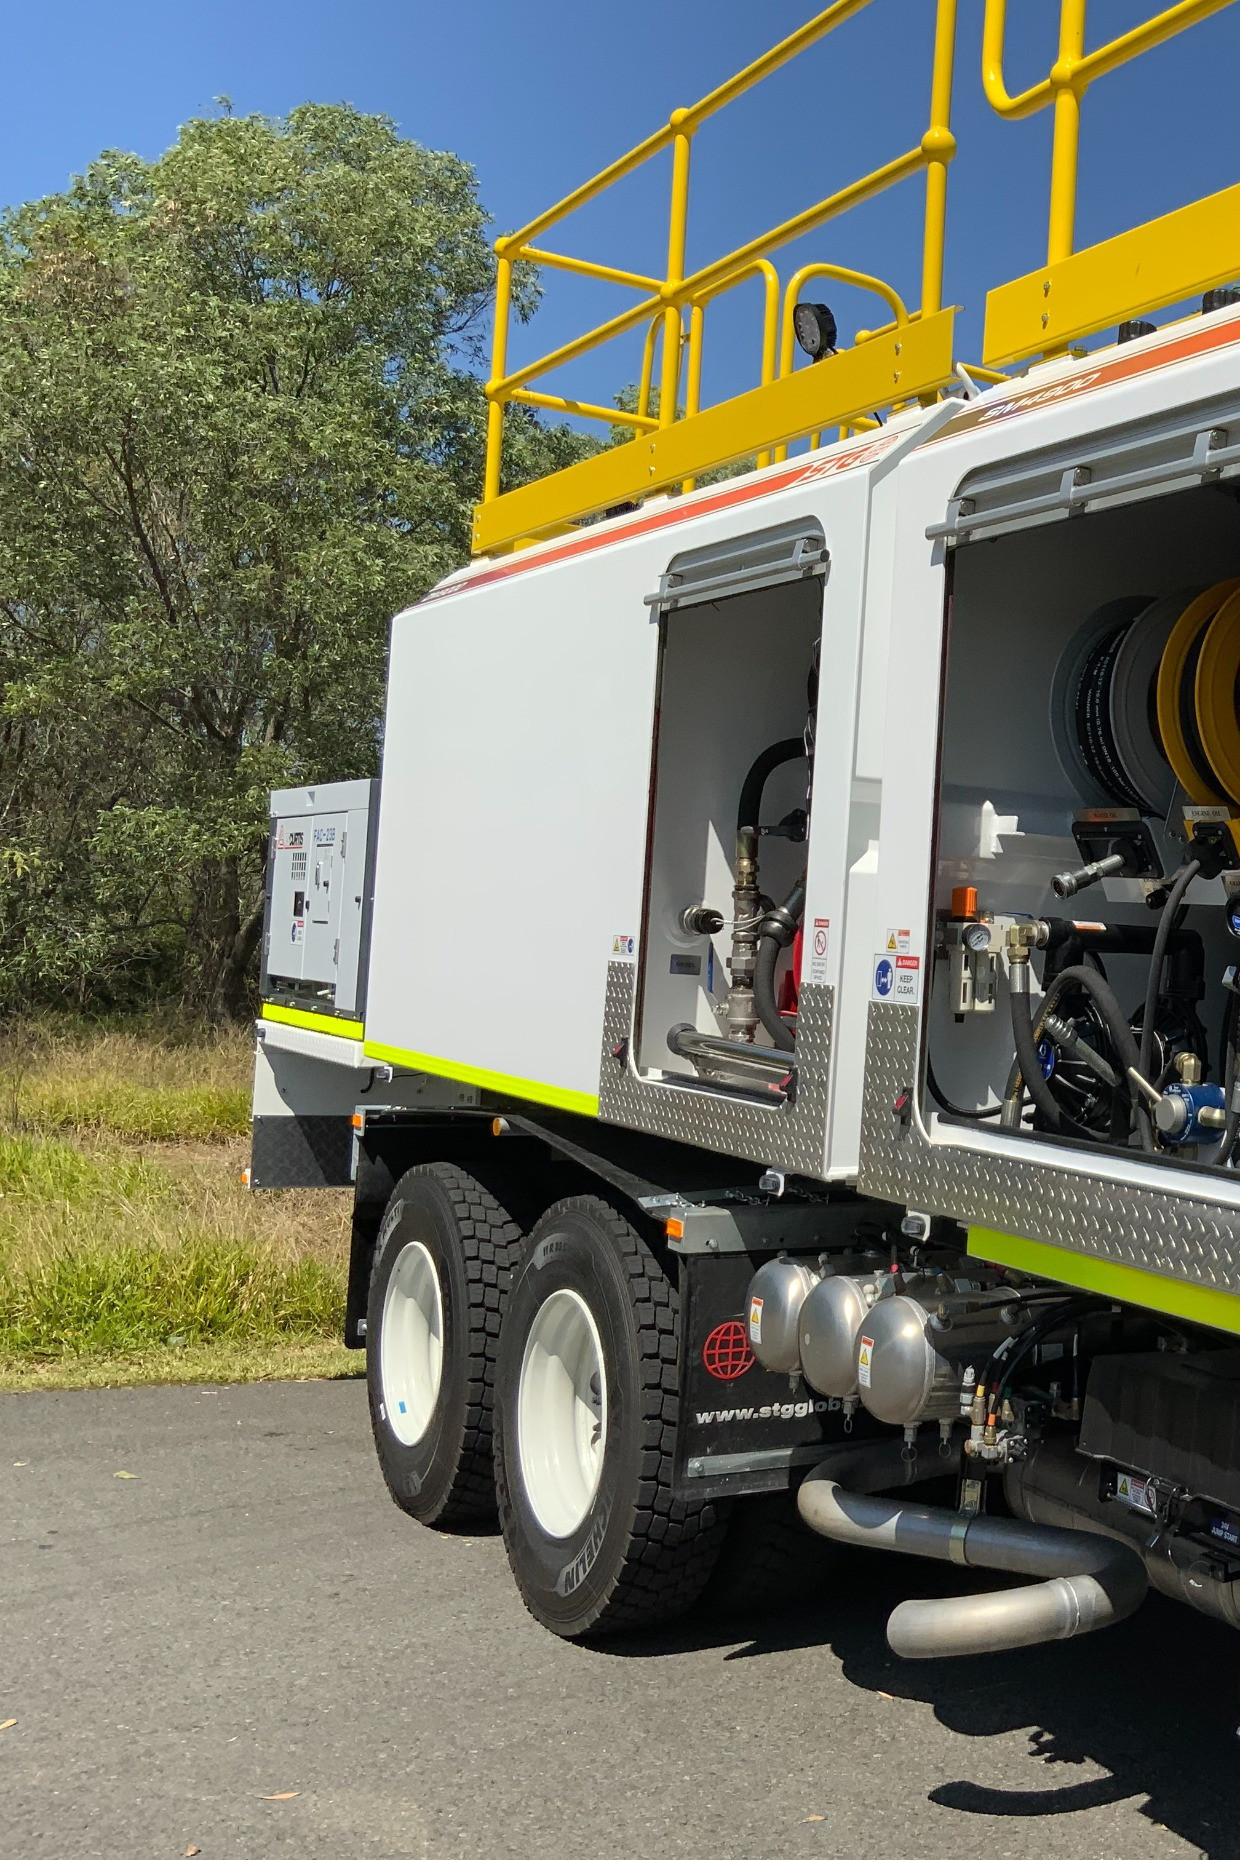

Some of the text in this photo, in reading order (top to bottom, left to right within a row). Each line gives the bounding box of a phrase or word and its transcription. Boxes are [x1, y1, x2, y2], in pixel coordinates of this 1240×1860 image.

[796, 444, 876, 483] STG
[899, 974, 914, 984] KEEP
[695, 1398, 842, 1425] www.stgglob
[1211, 1526, 1238, 1543] JUMP START
